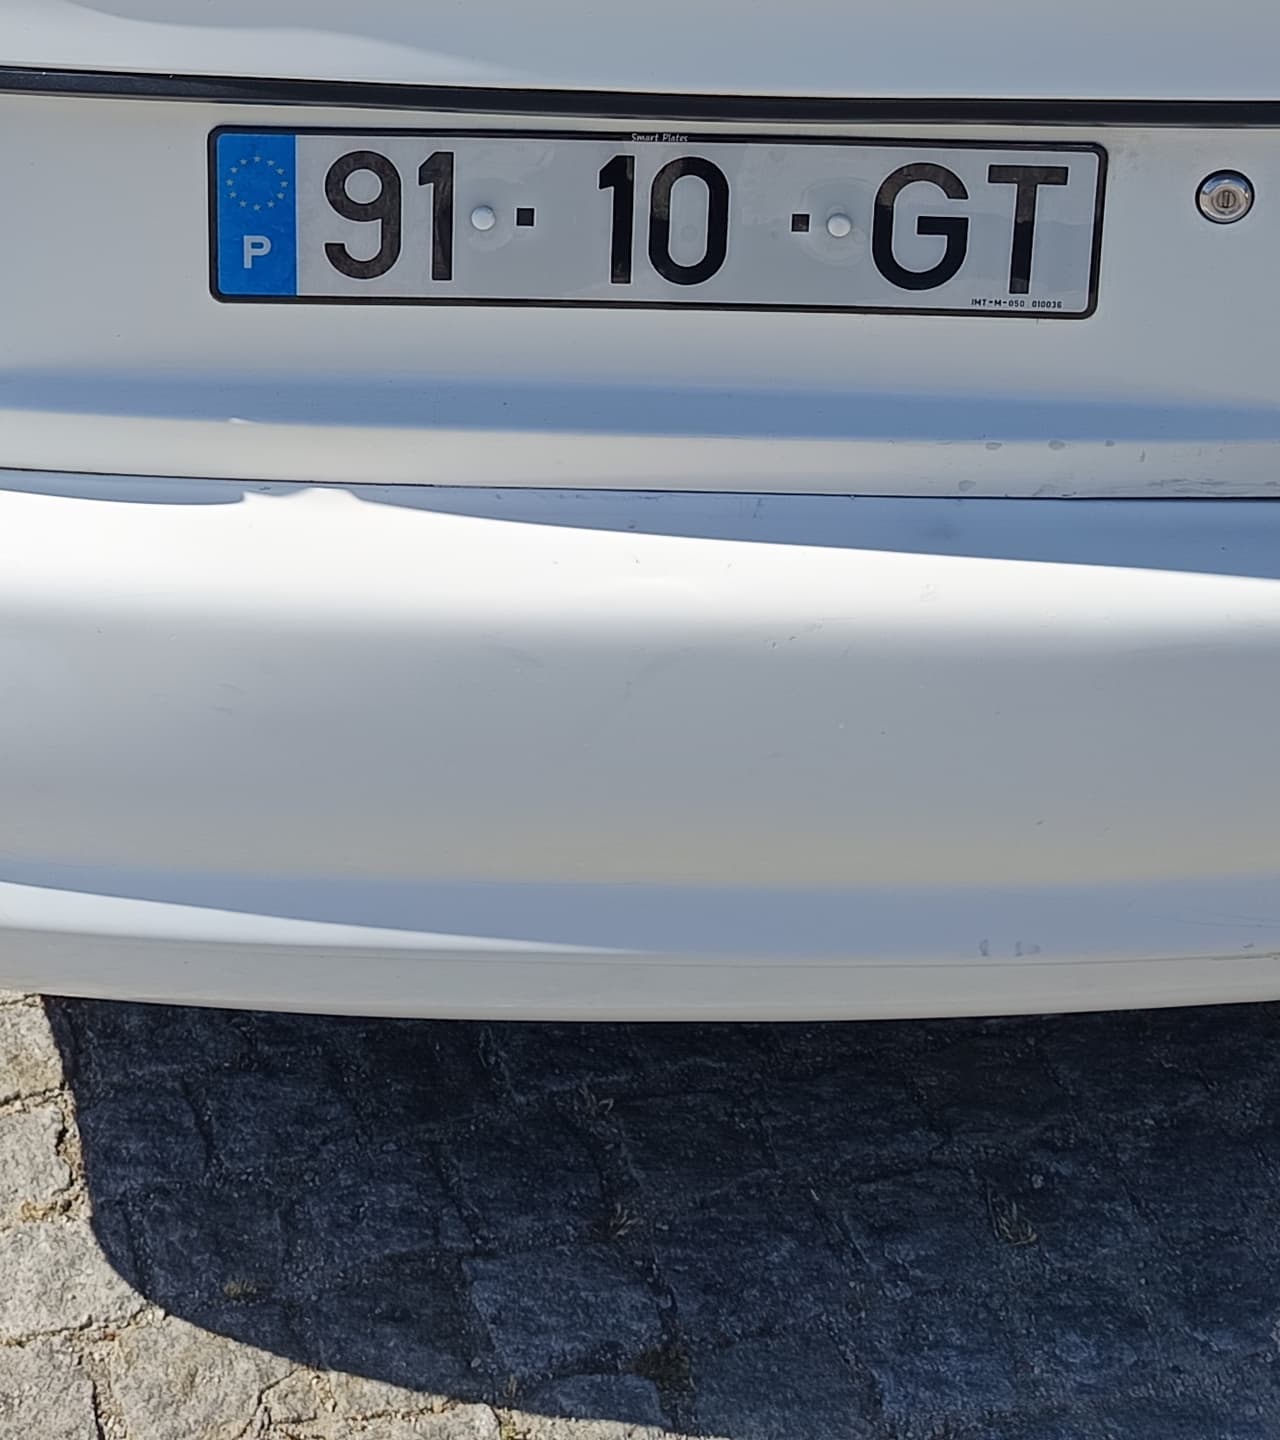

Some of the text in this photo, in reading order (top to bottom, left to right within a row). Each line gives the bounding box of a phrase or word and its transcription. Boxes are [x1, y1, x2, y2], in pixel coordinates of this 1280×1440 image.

[631, 132, 689, 143] Smart Plates
[243, 235, 272, 269] P
